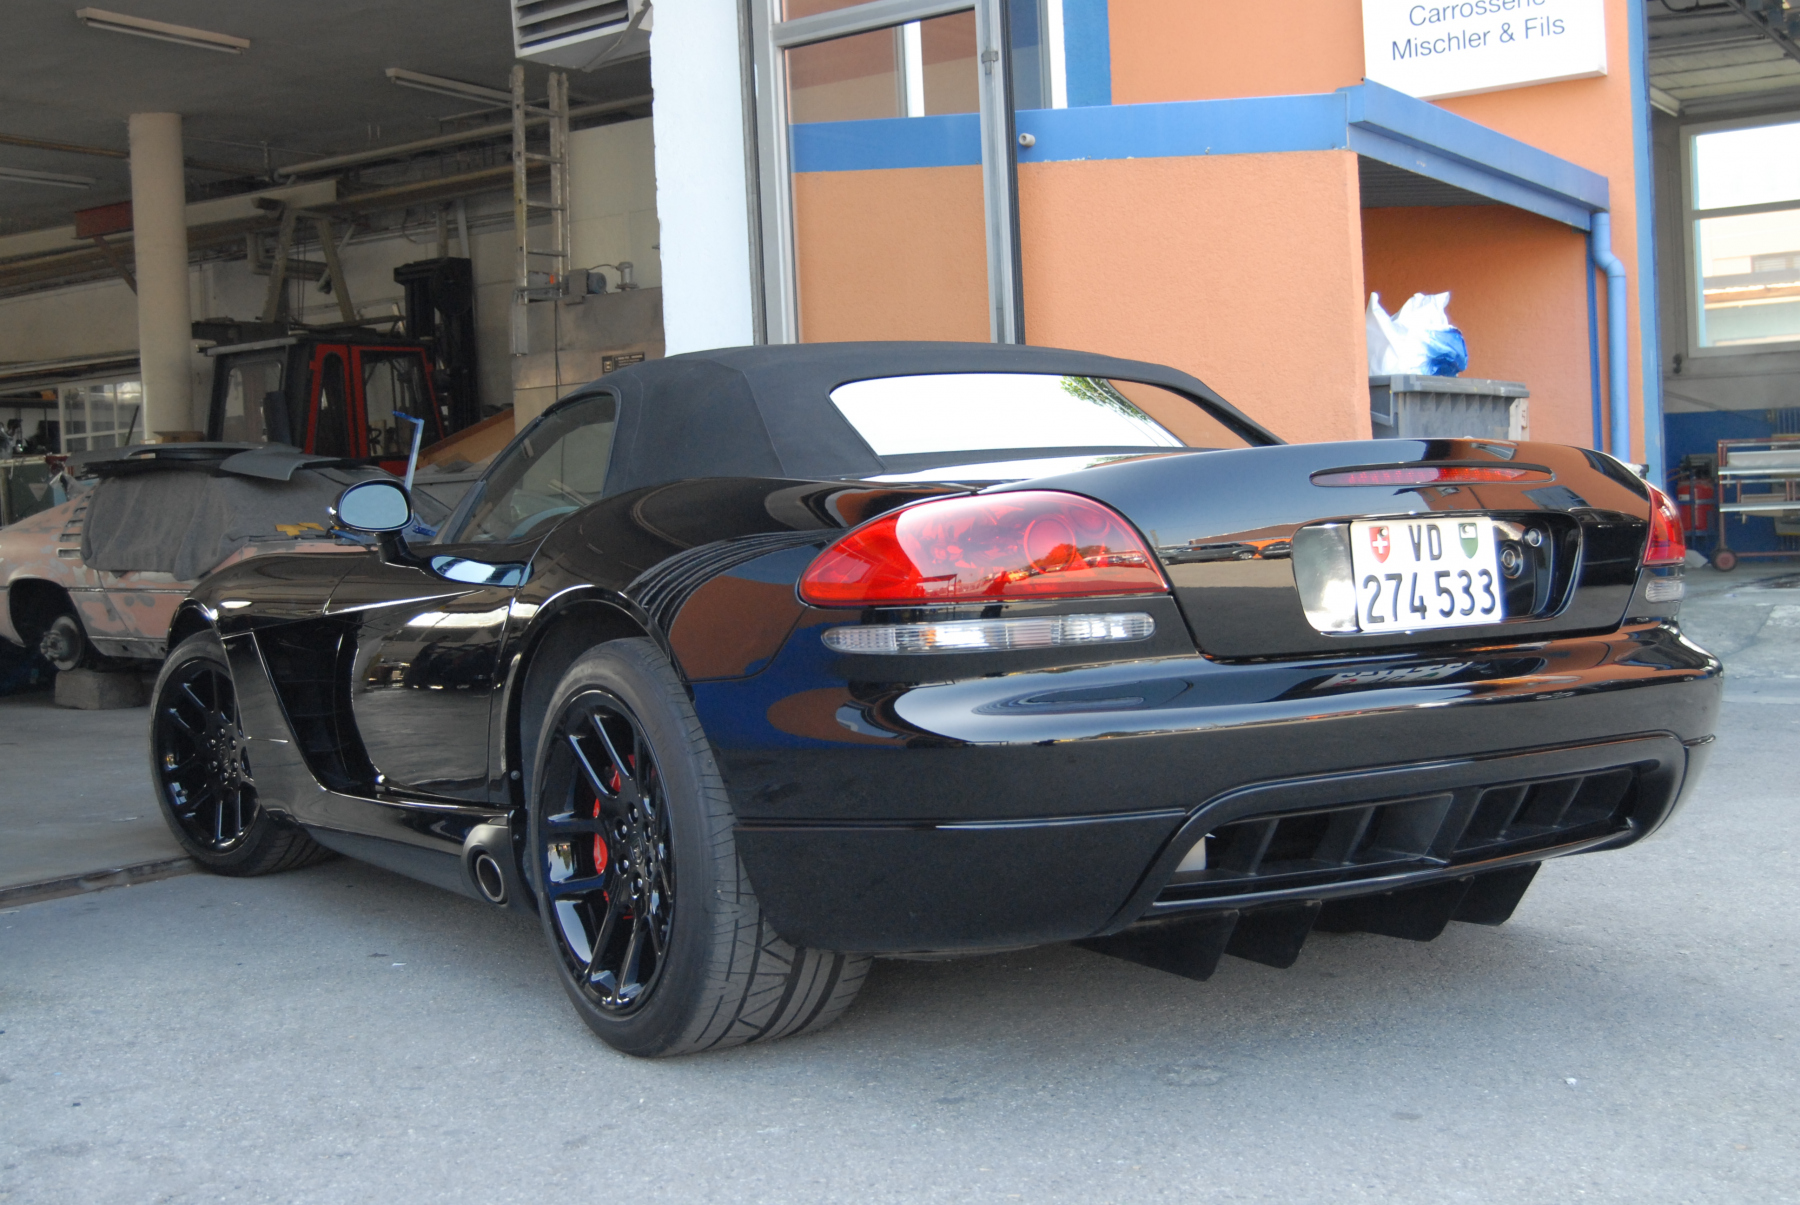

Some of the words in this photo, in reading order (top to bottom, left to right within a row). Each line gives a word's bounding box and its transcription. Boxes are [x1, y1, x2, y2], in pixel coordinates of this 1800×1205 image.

[1392, 30, 1491, 60] Mischler
[1499, 22, 1516, 43] &
[1525, 16, 1566, 39] Fils
[1408, 524, 1442, 561] VD
